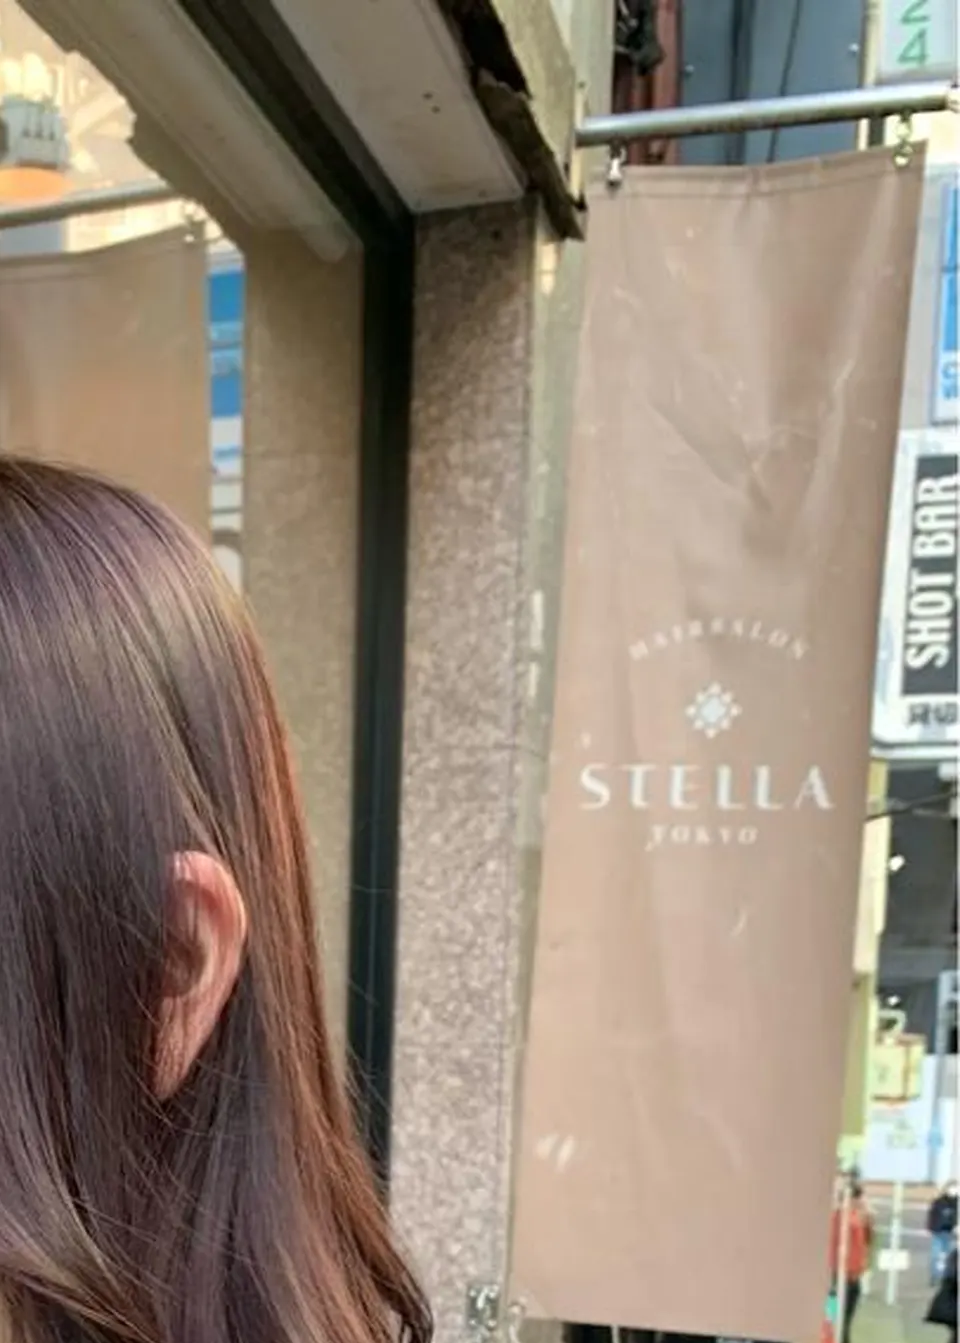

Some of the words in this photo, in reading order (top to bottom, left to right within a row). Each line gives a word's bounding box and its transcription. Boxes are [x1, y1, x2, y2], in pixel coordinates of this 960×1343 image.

[912, 471, 960, 559] BAR
[906, 565, 954, 670] SHOT
[578, 762, 836, 811] STELLA
[646, 822, 759, 846] TOKYO
